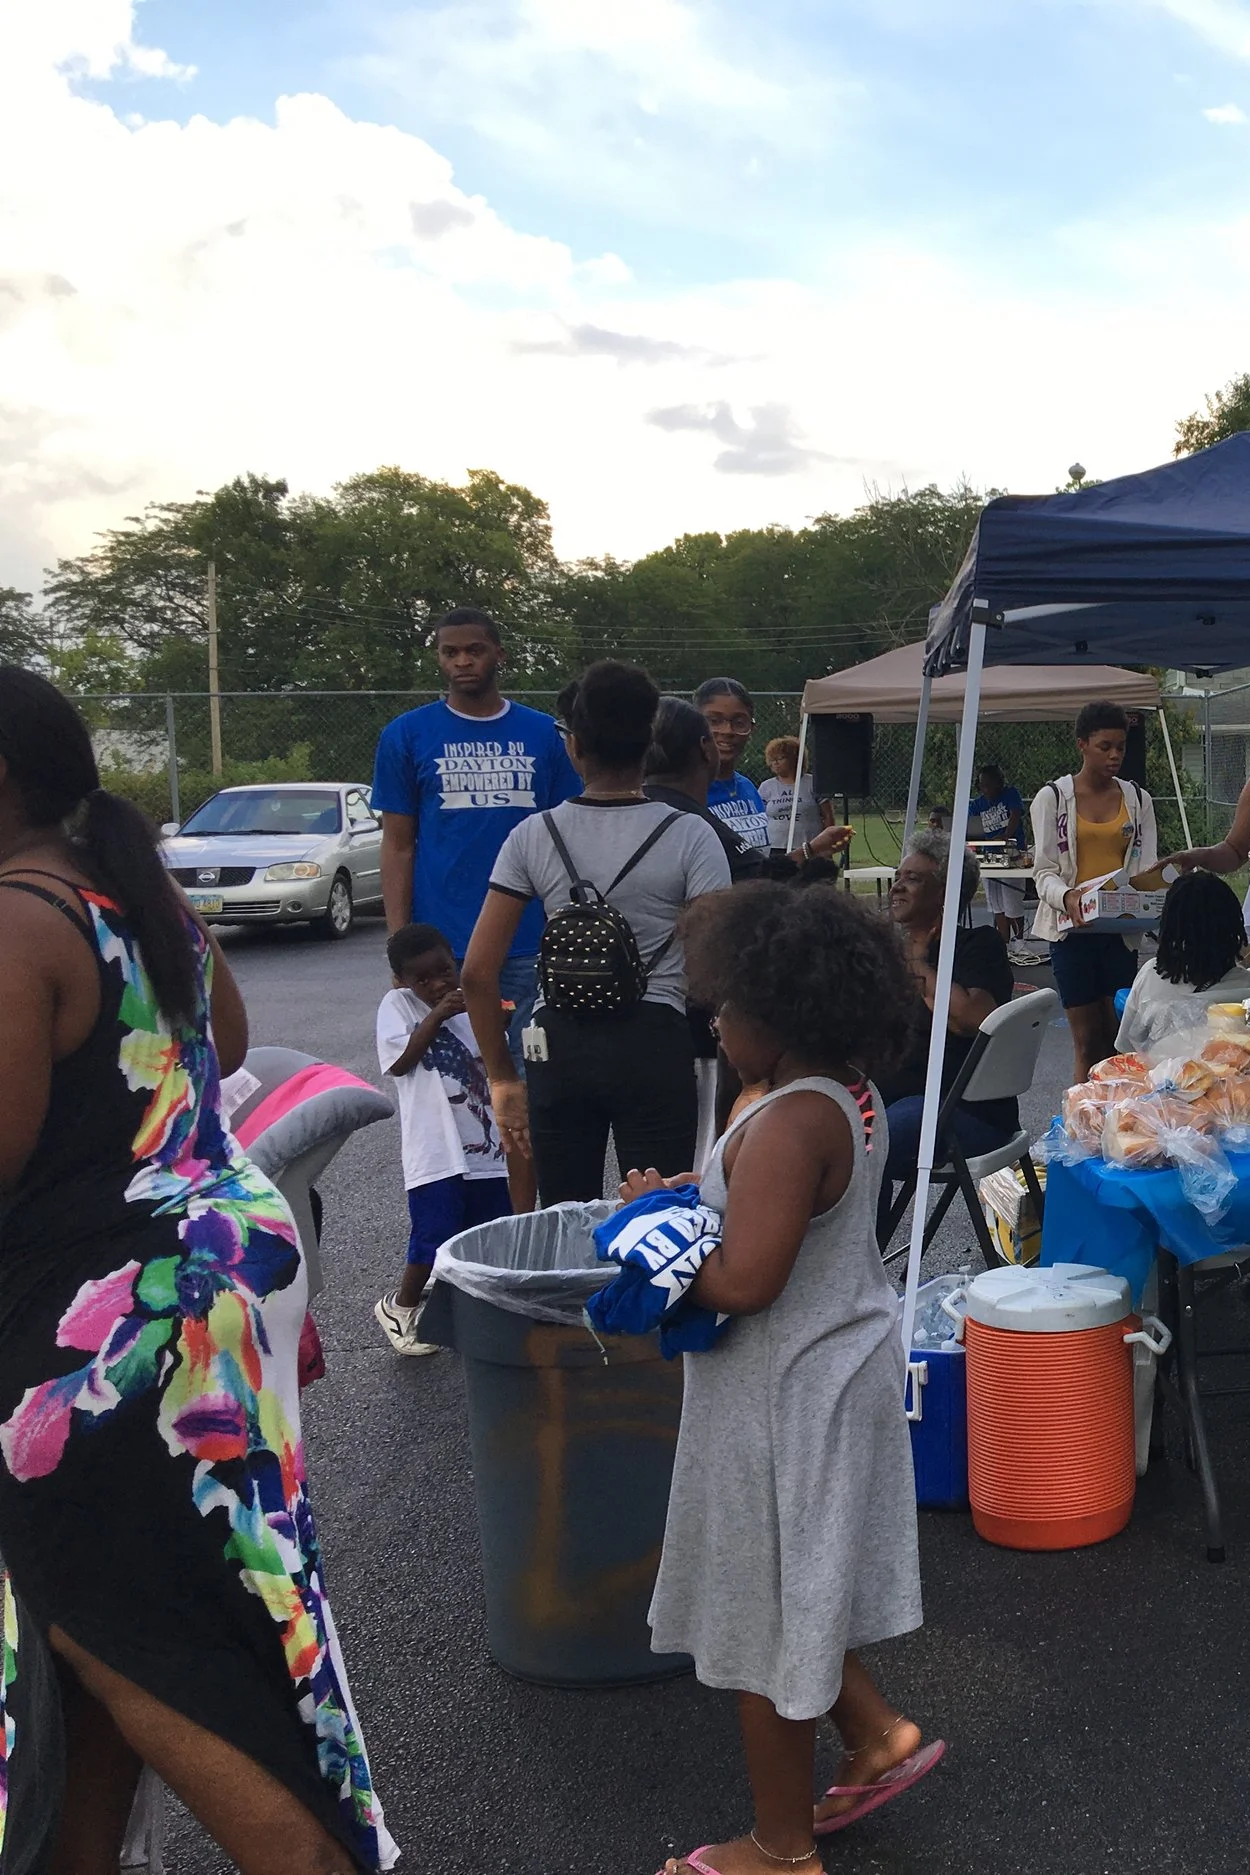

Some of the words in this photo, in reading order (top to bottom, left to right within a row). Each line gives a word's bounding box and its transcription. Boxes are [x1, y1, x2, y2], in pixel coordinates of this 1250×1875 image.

[443, 741, 502, 757] INSPIRED
[508, 741, 525, 756] BY
[445, 757, 528, 771] DAYTON
[442, 771, 514, 792] EMPOWERED
[517, 771, 533, 790] BY
[470, 792, 511, 807] US
[729, 813, 769, 831] AYTON
